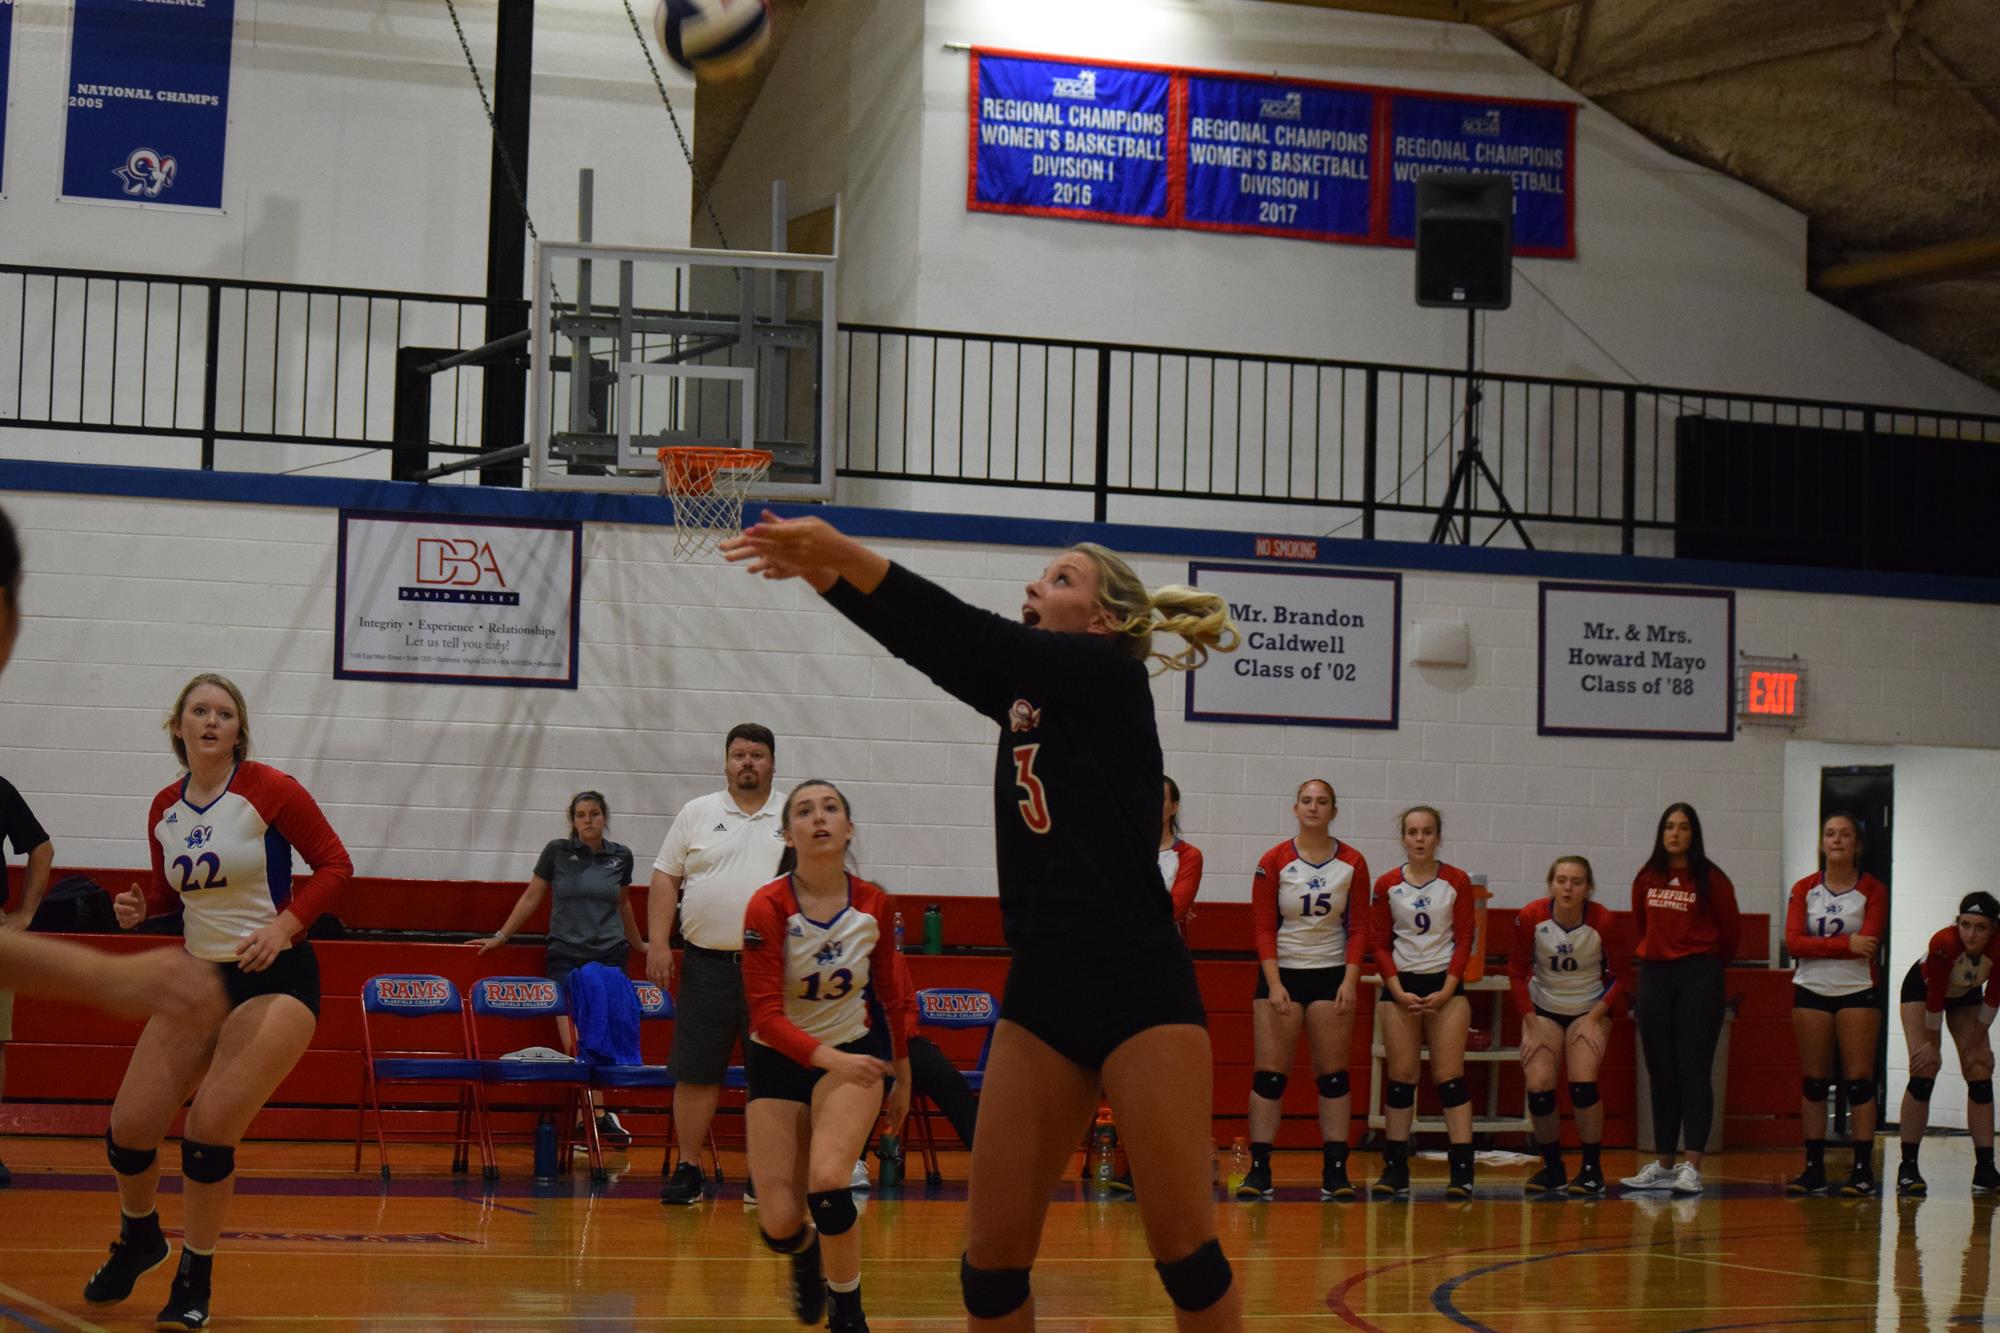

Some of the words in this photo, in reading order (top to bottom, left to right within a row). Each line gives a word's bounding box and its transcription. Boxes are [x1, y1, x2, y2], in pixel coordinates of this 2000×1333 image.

[69, 96, 103, 109] 2005
[77, 83, 153, 100] NATIONAL
[157, 90, 219, 106] CHAMPS
[982, 98, 1064, 125] REGIONAL
[1068, 104, 1164, 135] CHAMPIONS
[981, 123, 1060, 151] WOMEN'S
[1065, 132, 1164, 161] BASKETBALL
[1192, 117, 1270, 145] REGIONAL
[1275, 125, 1368, 154] CHAMPIONS
[1190, 143, 1267, 171] WOMEN'S
[1271, 151, 1368, 179] BASKETBALL
[1395, 136, 1470, 161] REGIONAL
[1475, 142, 1564, 169] CHAMPIONS
[1032, 155, 1104, 180] DIVISION
[1108, 161, 1113, 182] I
[1053, 182, 1092, 206] 2016
[1241, 173, 1309, 199] DIVISION
[1314, 181, 1319, 200] I
[1259, 202, 1297, 224] 2017
[1256, 538, 1271, 556] NO
[1274, 539, 1317, 559] SMOKING
[416, 538, 505, 587] DBA
[402, 591, 450, 600] DAVID
[459, 593, 515, 602] BAILEY
[359, 616, 403, 631] Integrity
[418, 619, 474, 634] Experience
[488, 622, 556, 639] Relationships
[1229, 604, 1267, 623] Mr.
[1273, 606, 1365, 628] Brandon
[405, 635, 424, 647] Let
[428, 639, 440, 648] us
[442, 637, 459, 649] tell
[462, 640, 481, 652] you
[485, 640, 510, 655] why!
[1248, 632, 1345, 654] Caldwell
[1584, 622, 1620, 640] Mr.
[1625, 624, 1641, 641] &
[1646, 625, 1692, 644] Mrs.
[1234, 658, 1294, 679] Class
[1300, 662, 1322, 680] of
[1328, 663, 1356, 681] '02
[1568, 648, 1645, 669] Howard
[1651, 651, 1706, 674] Mayo
[1581, 674, 1636, 694] Class
[1642, 678, 1664, 695] of
[1667, 678, 1694, 696] '88
[1749, 671, 1798, 715] EXIT
[1013, 743, 1052, 834] 3
[172, 852, 227, 892] 22
[1299, 893, 1332, 917] 15
[1414, 912, 1431, 936] 9
[1816, 917, 1845, 937] 12
[1548, 955, 1578, 972] 10
[378, 980, 449, 999] RAMS
[486, 983, 555, 1002] RAMS
[799, 968, 852, 1000] 13
[924, 994, 990, 1012] RAMS
